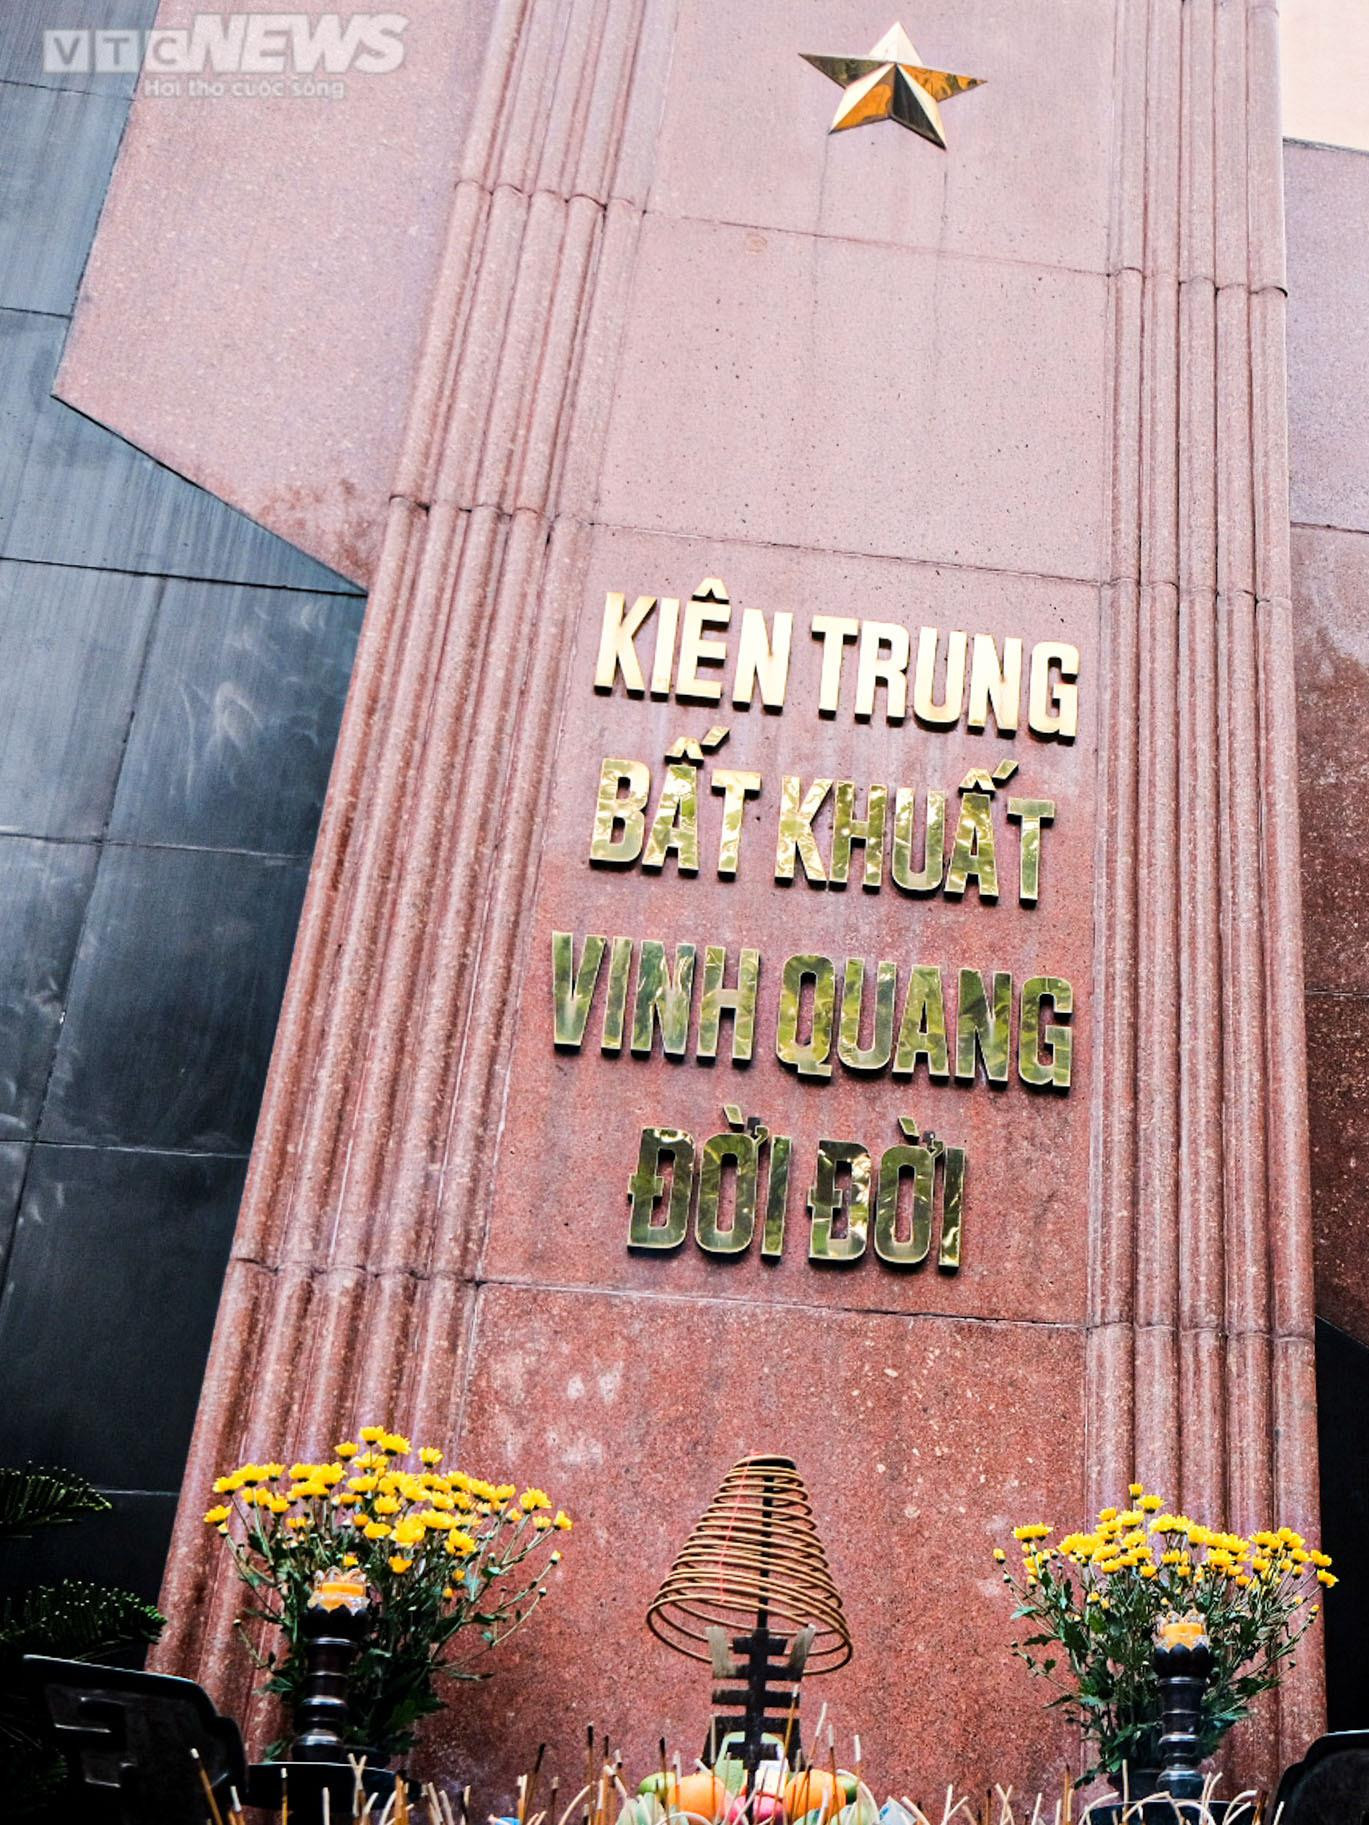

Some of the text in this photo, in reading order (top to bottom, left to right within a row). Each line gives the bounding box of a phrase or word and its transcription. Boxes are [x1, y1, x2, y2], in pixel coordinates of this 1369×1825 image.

[593, 577, 1080, 746] KIÊN TRUNG
[589, 726, 1057, 908] BẤT KHUẤT
[551, 930, 1074, 1093] VINH QUANG
[626, 1103, 967, 1275] ĐỜI ĐỜI
